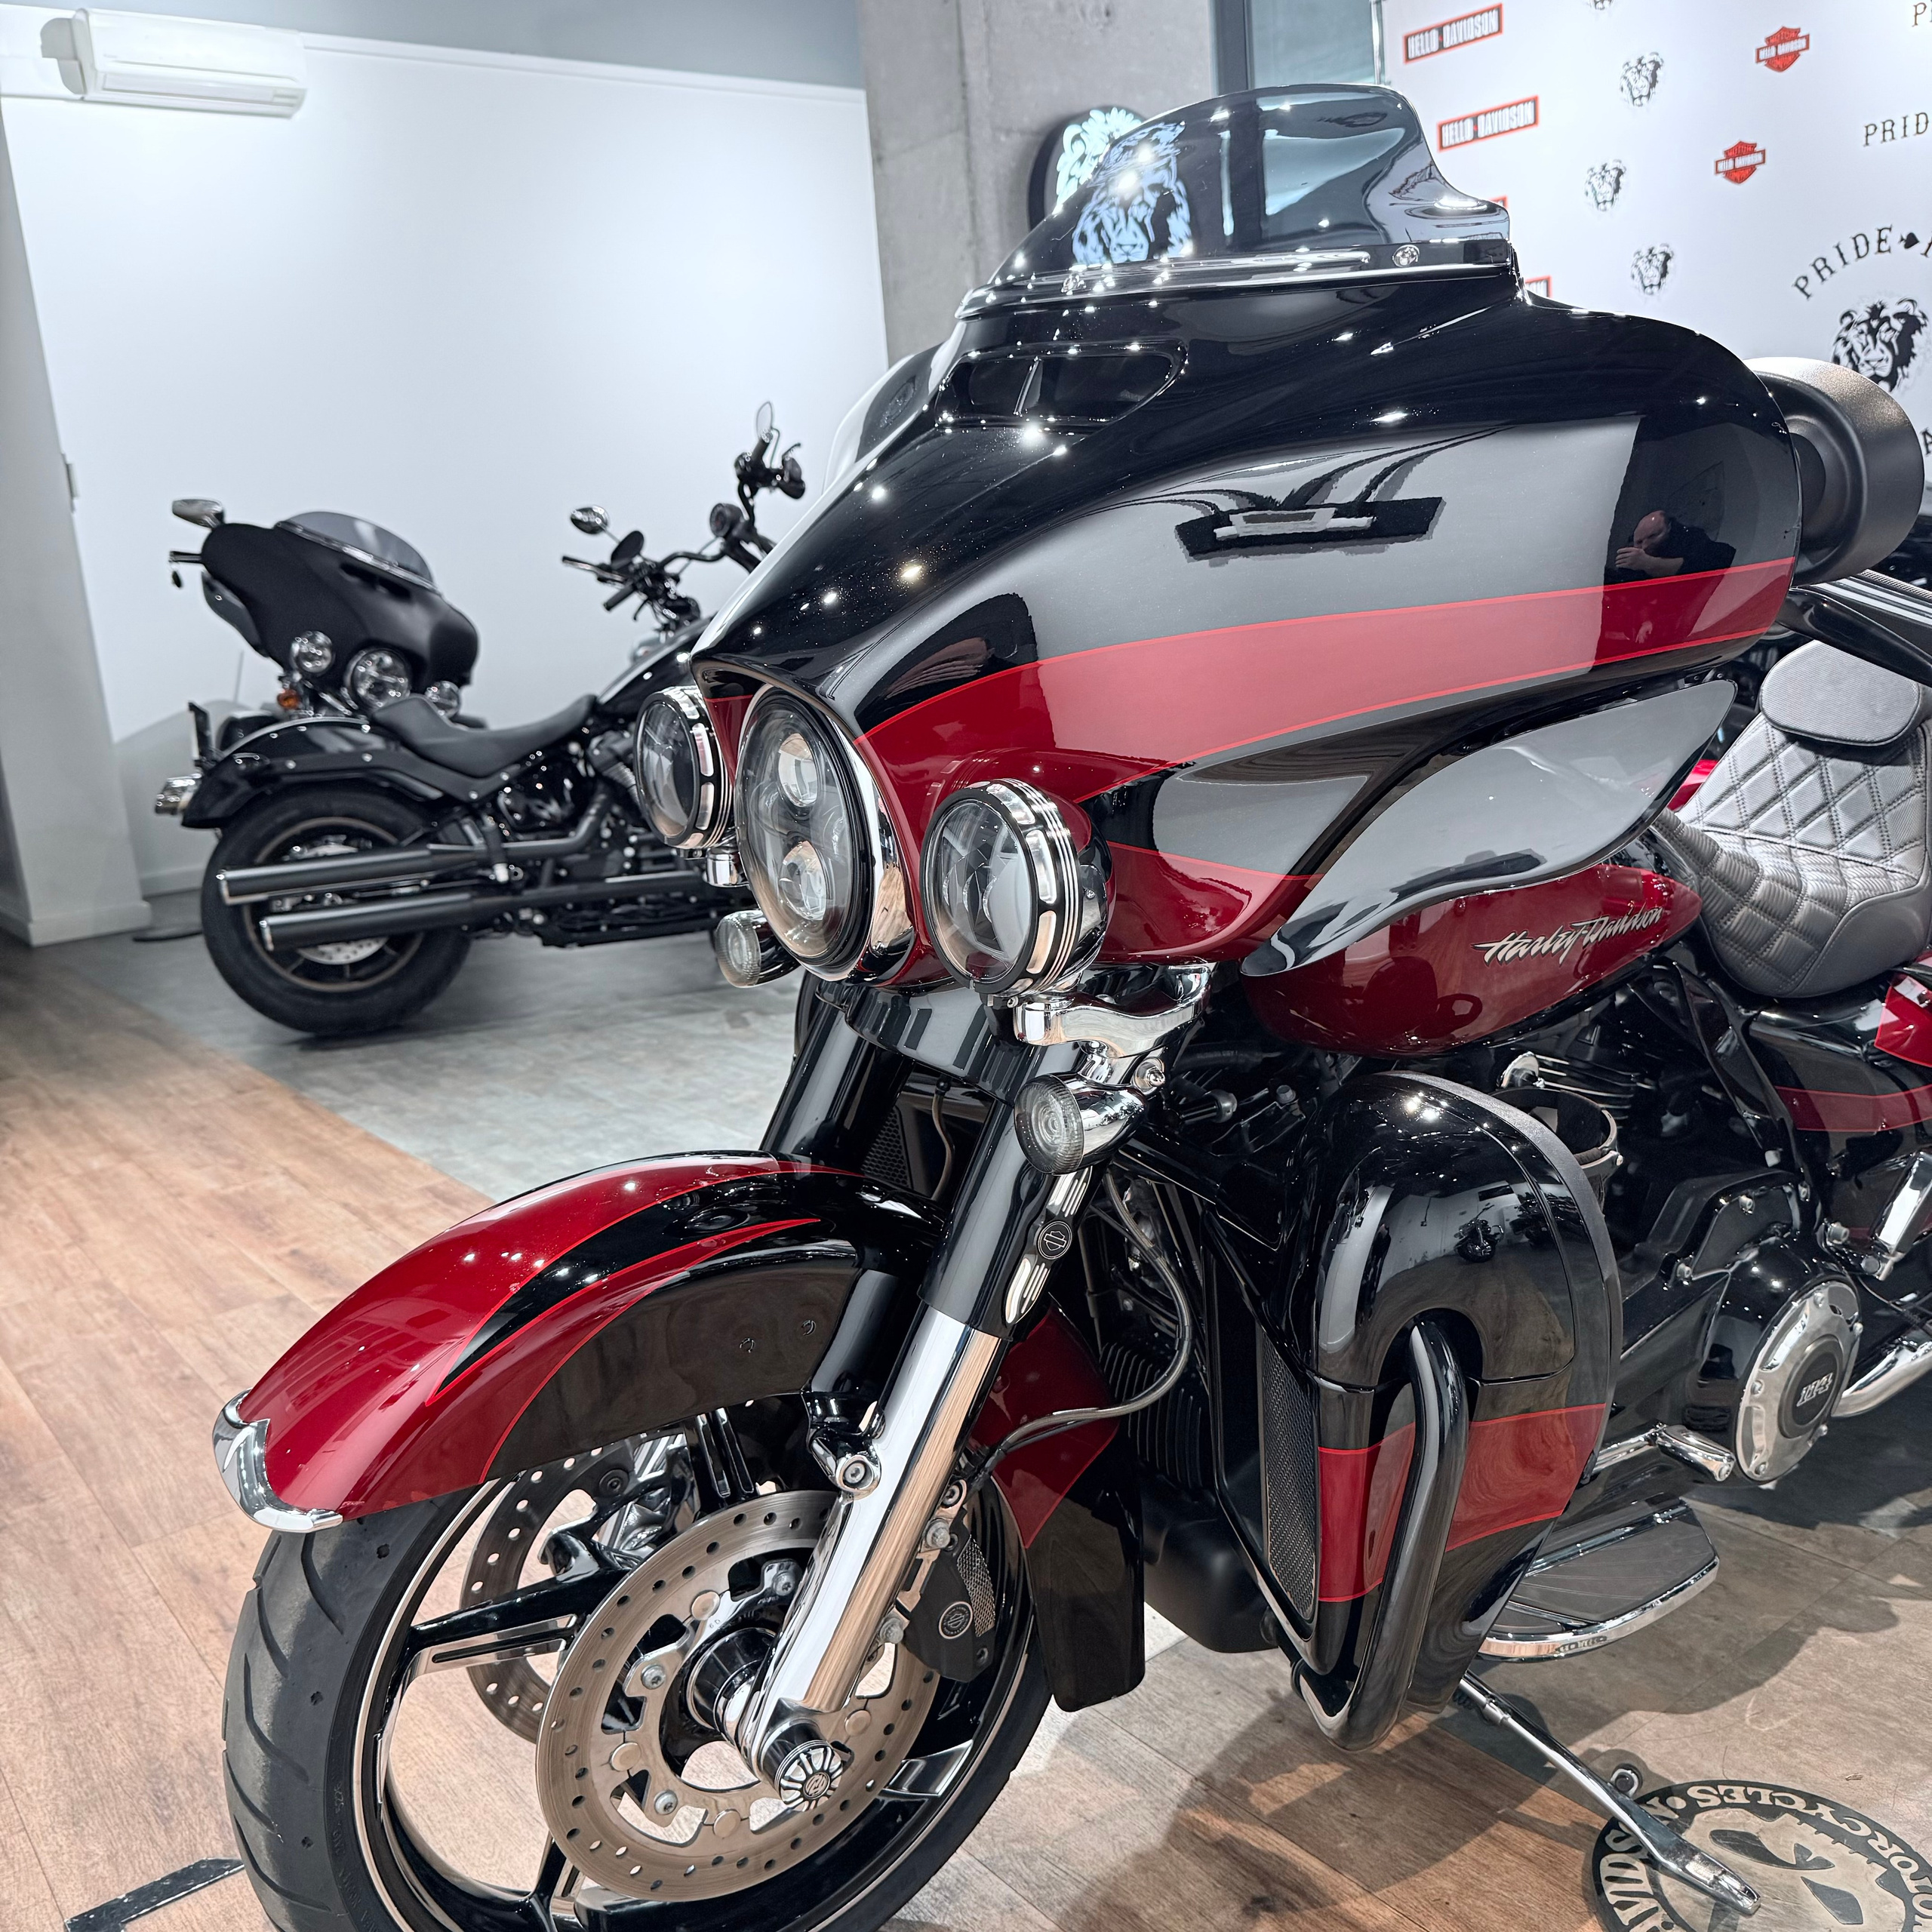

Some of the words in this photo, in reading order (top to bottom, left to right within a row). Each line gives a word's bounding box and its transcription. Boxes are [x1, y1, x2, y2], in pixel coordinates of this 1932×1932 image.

[1407, 28, 1439, 60] HELLO
[1442, 8, 1500, 48] DAVIDSON
[1441, 117, 1474, 148] HELLO
[1477, 100, 1536, 138] DAVIDSON
[1792, 224, 1893, 300] PRIDE
[1472, 903, 1663, 966] Harley-Davidson
